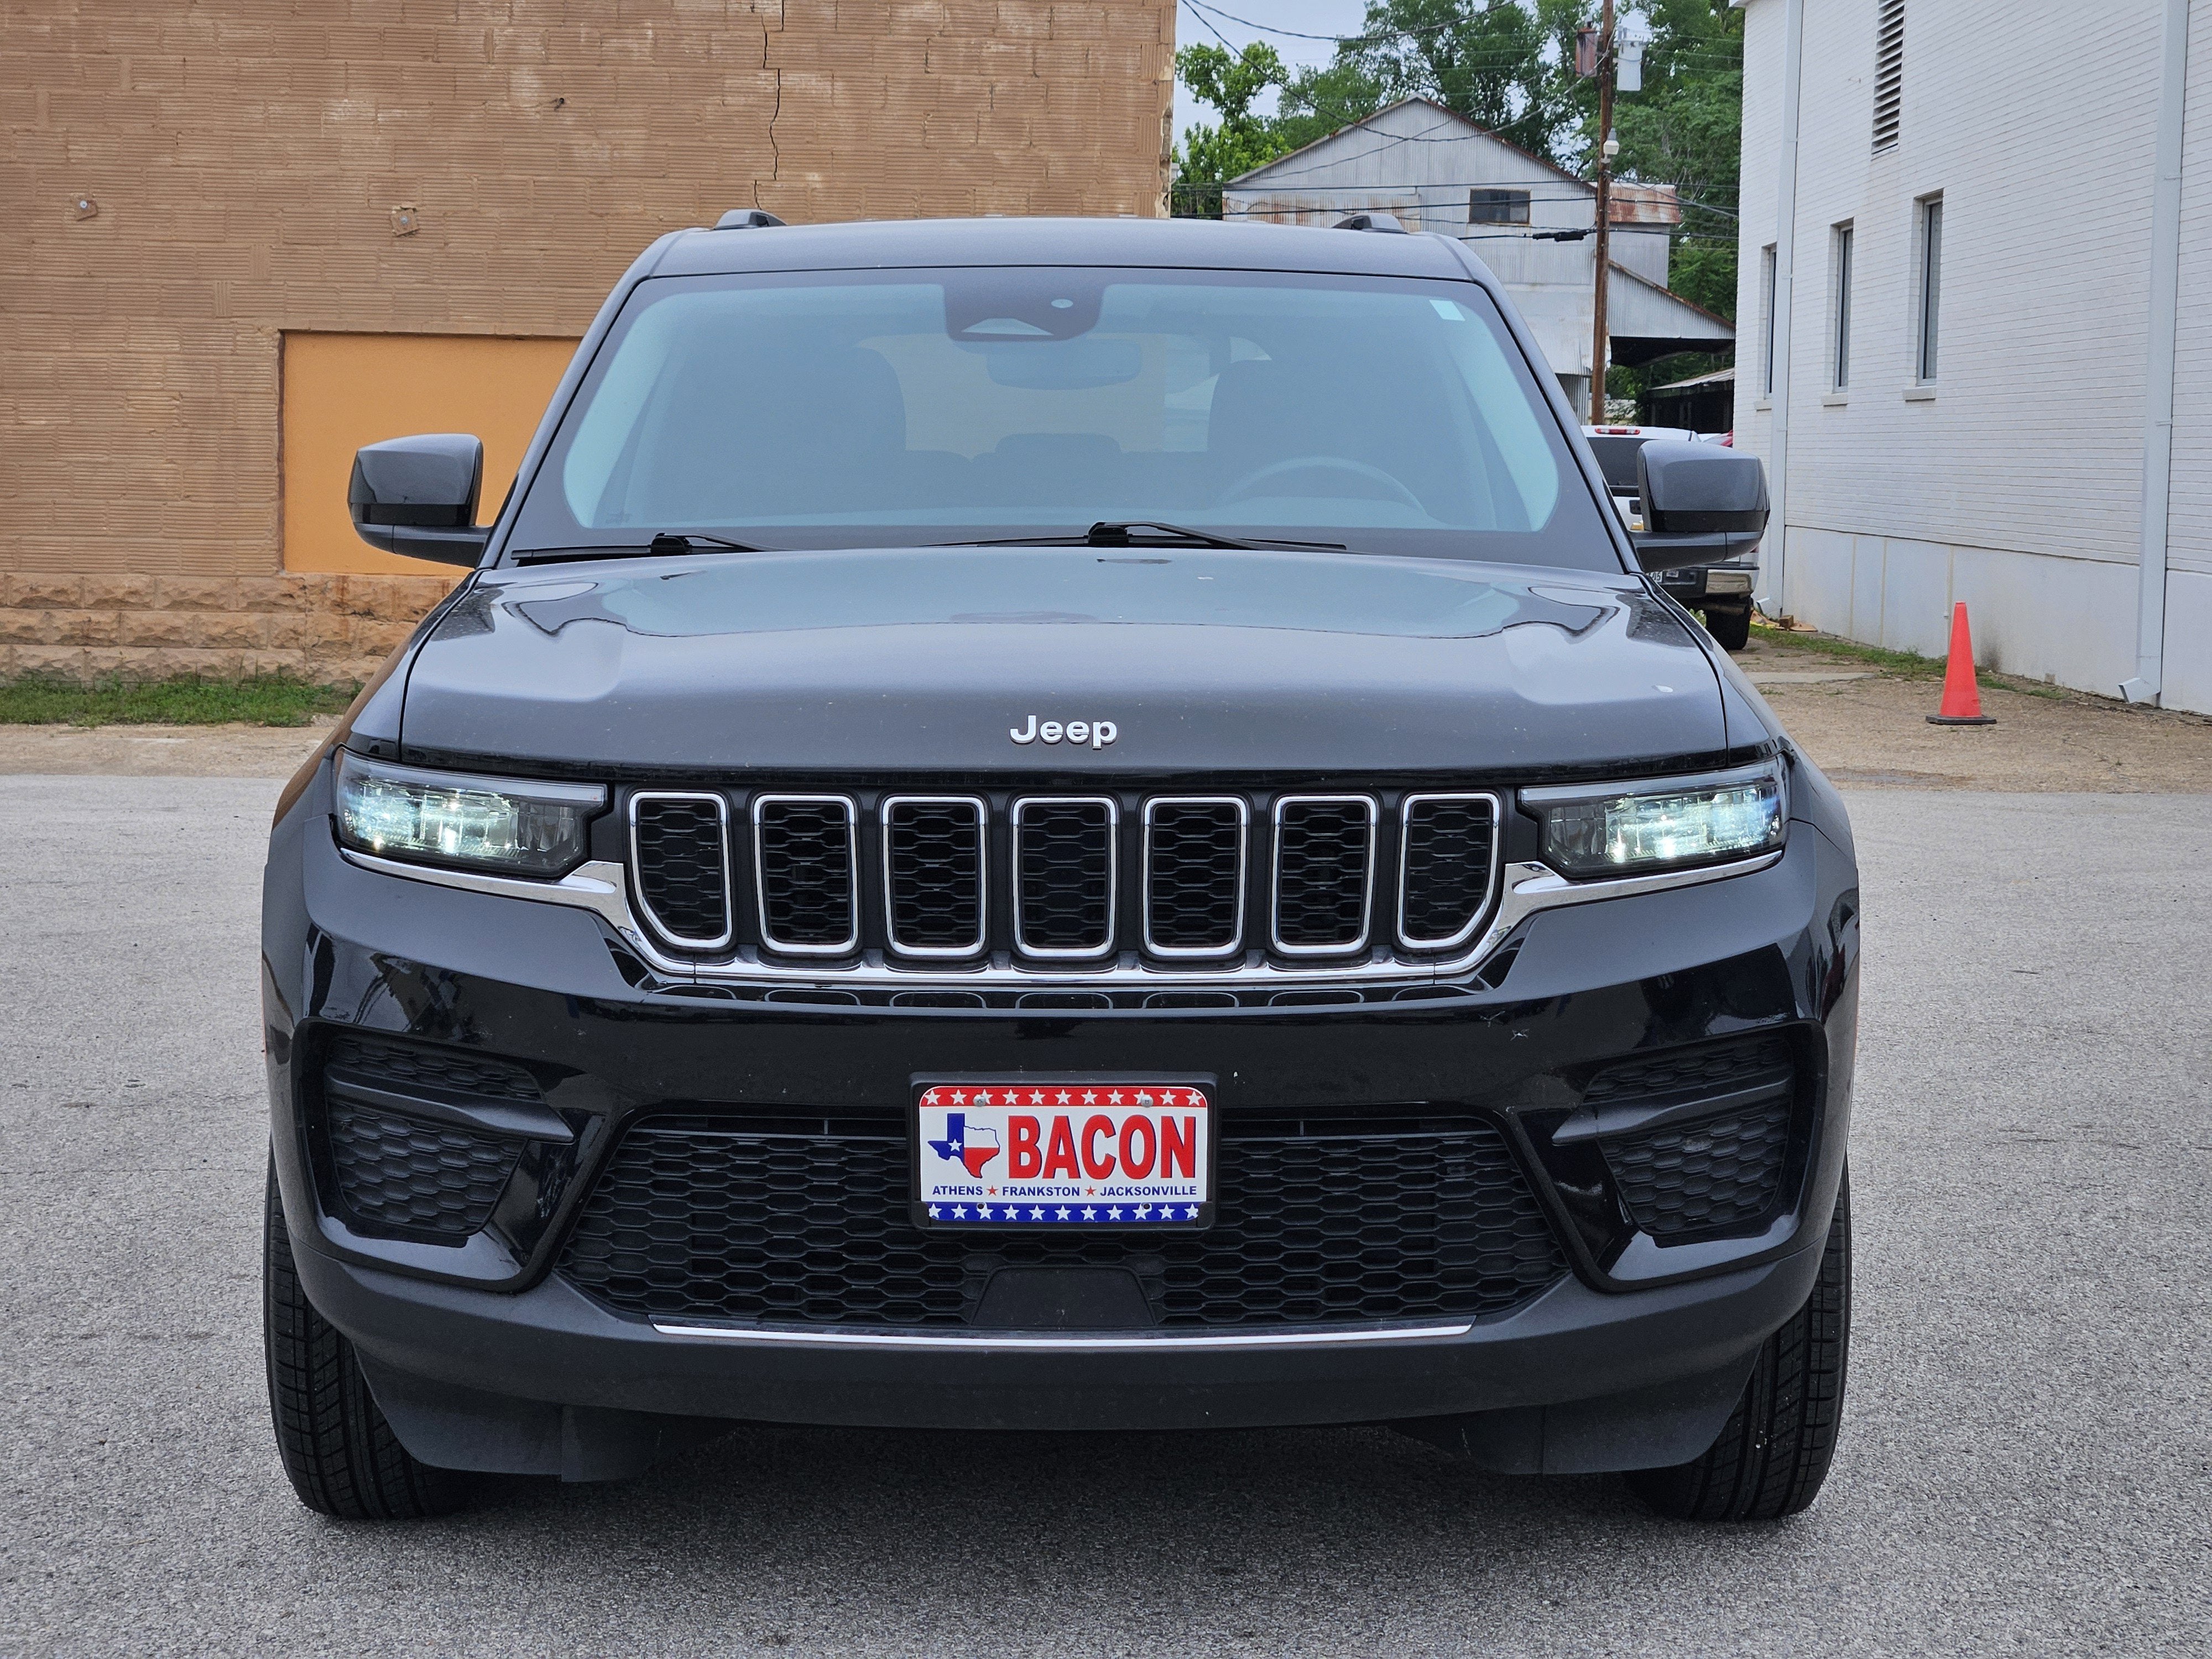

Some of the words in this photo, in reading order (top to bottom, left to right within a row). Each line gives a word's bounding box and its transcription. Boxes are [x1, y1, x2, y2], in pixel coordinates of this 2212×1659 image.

[1010, 714, 1117, 749] Jeep
[1008, 1114, 1197, 1180] BACON
[932, 1186, 983, 1196] ATHENS
[1002, 1186, 1080, 1197] FRANKSTON
[1099, 1186, 1197, 1196] JACKSONVILLE
